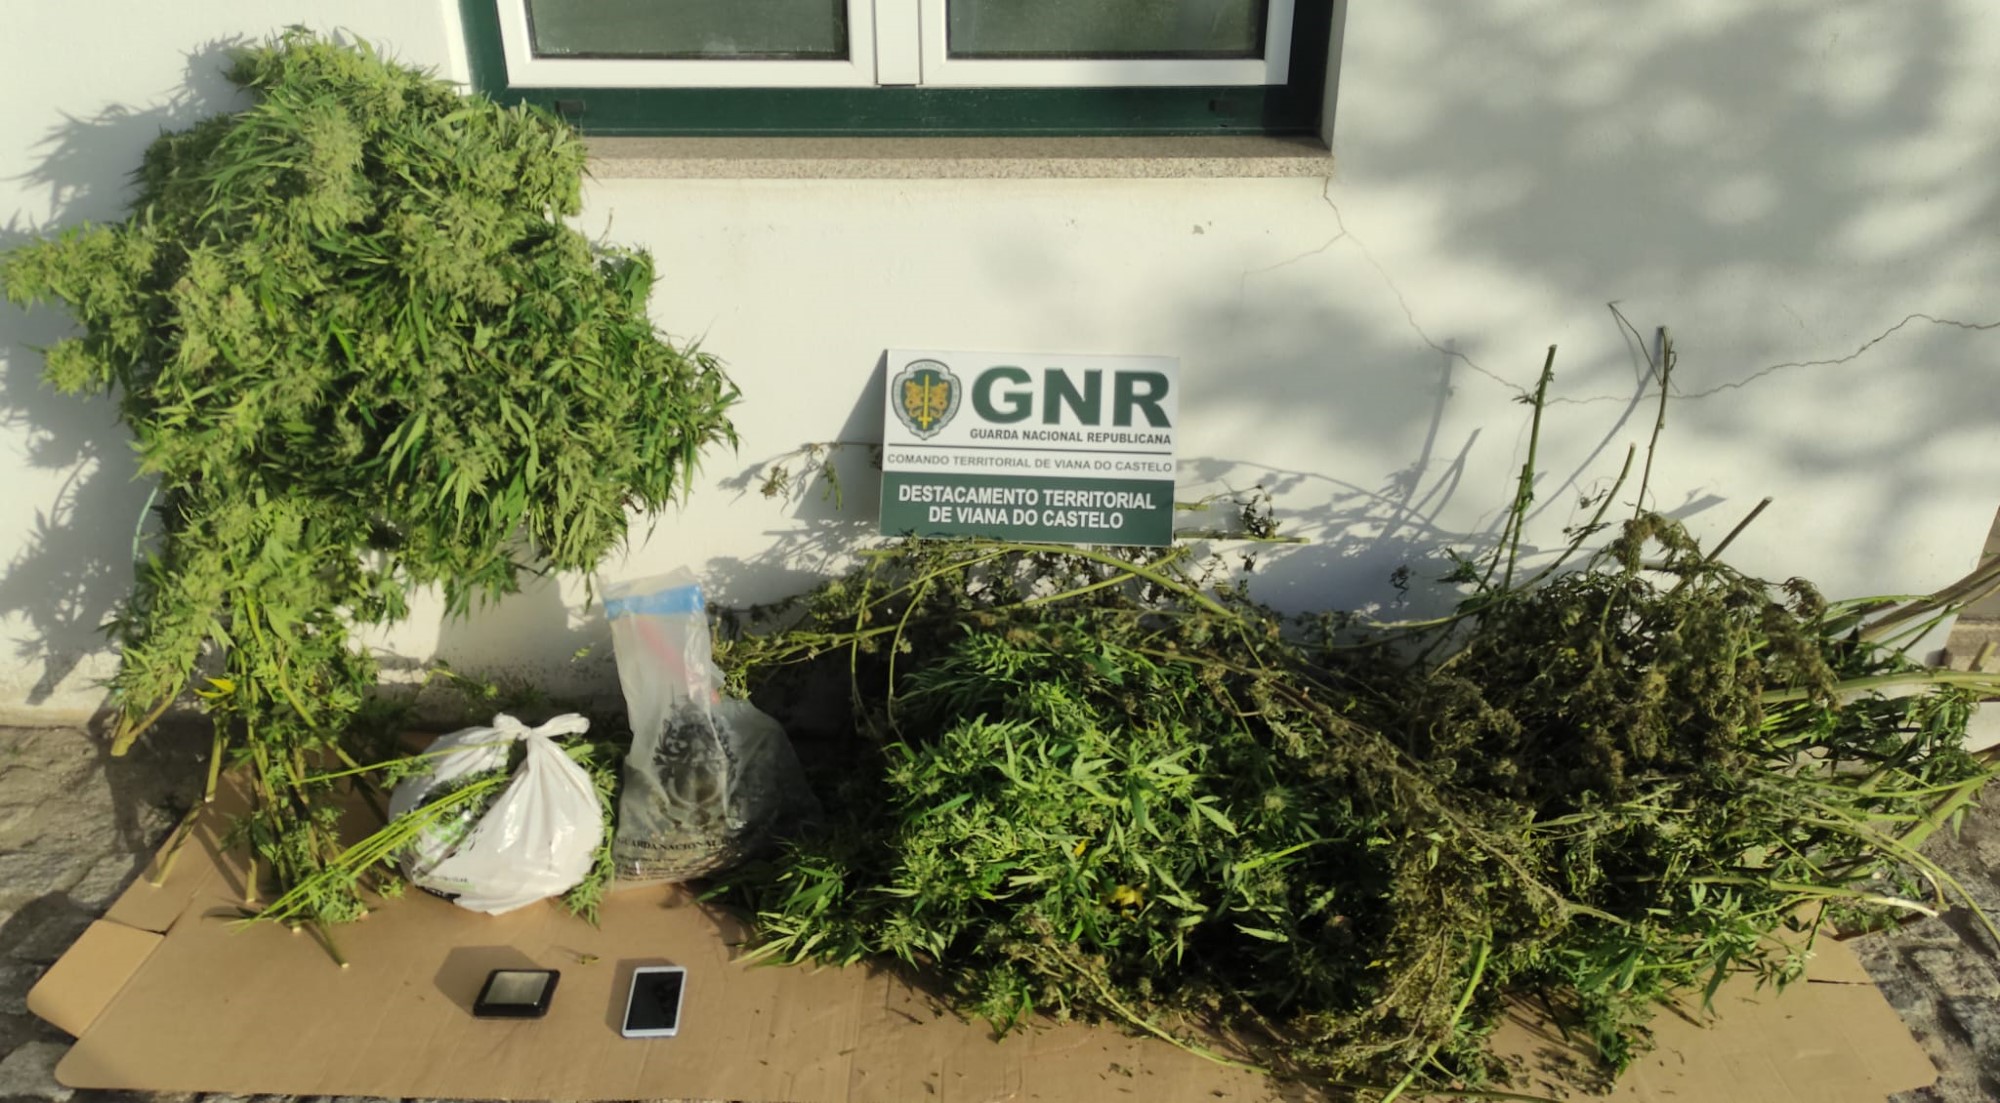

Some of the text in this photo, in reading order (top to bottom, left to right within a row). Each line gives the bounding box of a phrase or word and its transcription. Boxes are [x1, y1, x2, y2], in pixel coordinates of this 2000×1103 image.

[971, 365, 1172, 428] GNR
[970, 429, 1172, 445] GUARDA NACIONAL REPUBLICANA
[887, 453, 1173, 473] COMANDO TERRITORIAL DE VIANA DO CASTELO
[899, 484, 1156, 509] DESTACAMENTO TERRITORIAL
[928, 506, 1124, 529] DE VIANA DO CASTELO
